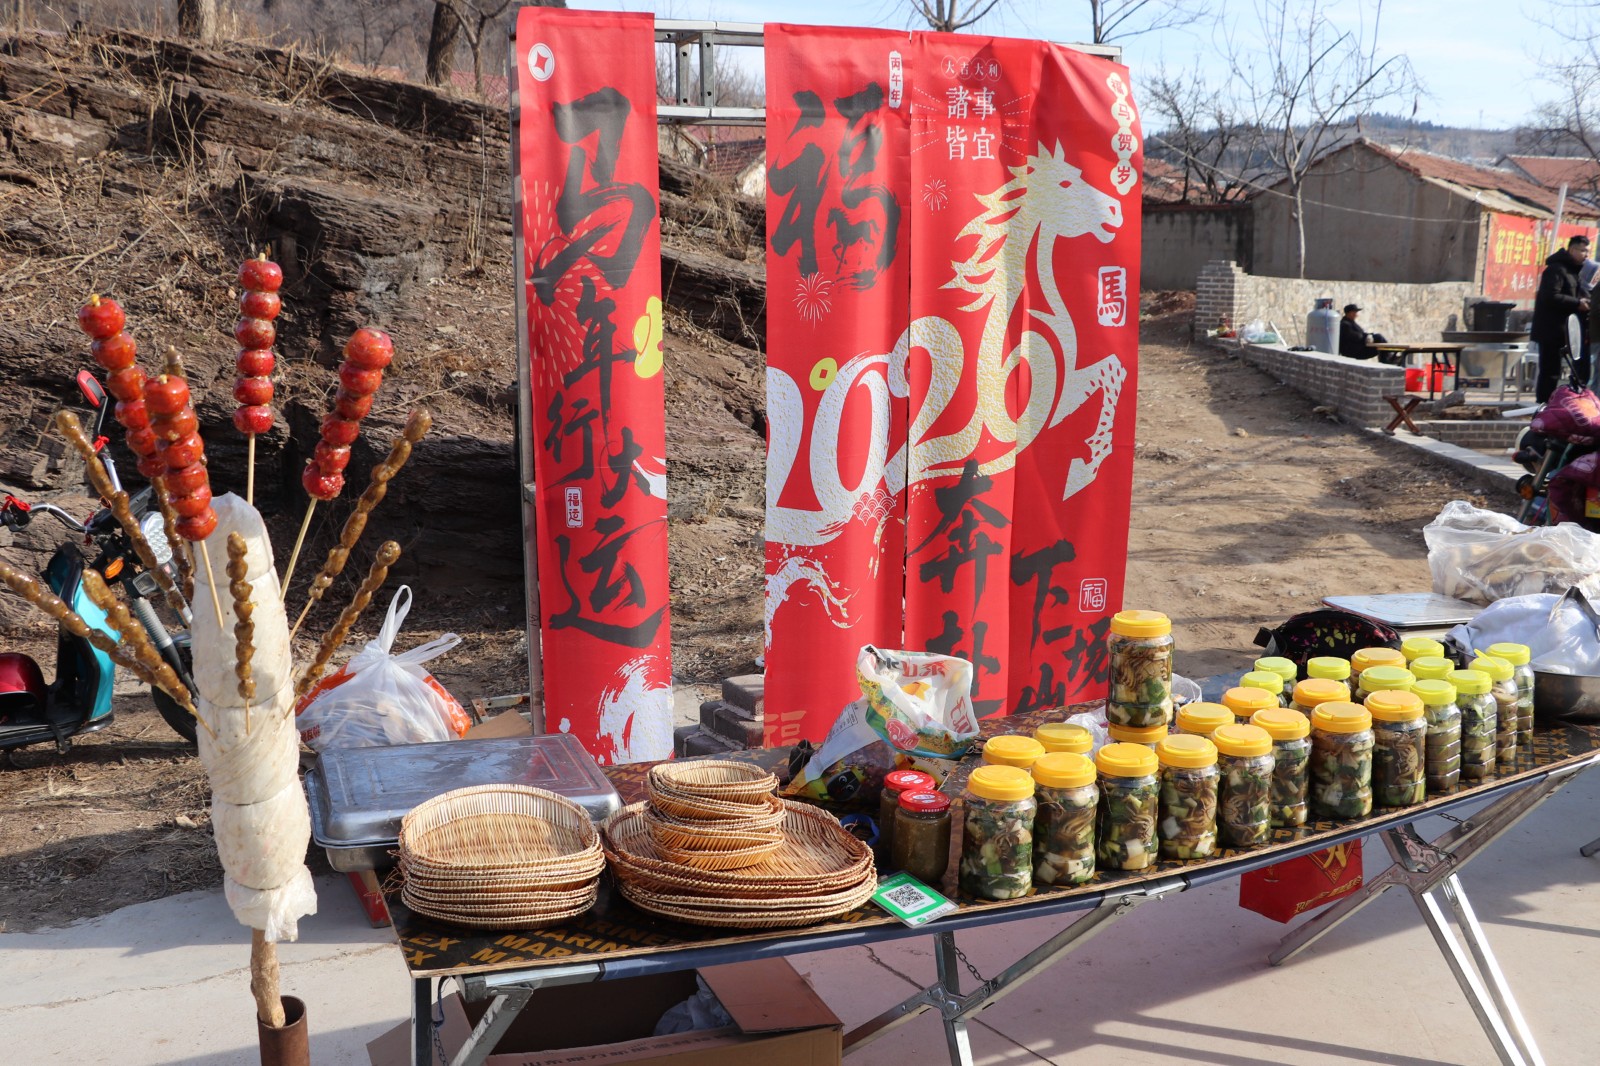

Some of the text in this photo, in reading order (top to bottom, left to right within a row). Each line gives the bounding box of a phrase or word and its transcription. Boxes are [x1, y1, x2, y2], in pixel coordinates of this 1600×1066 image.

[890, 56, 902, 103] 丙午年
[944, 59, 999, 77] 大吉大利
[945, 85, 997, 121] 諸事
[945, 125, 997, 161] 皆宜
[1098, 269, 1125, 325] 馬
[1082, 583, 1105, 609] 福
